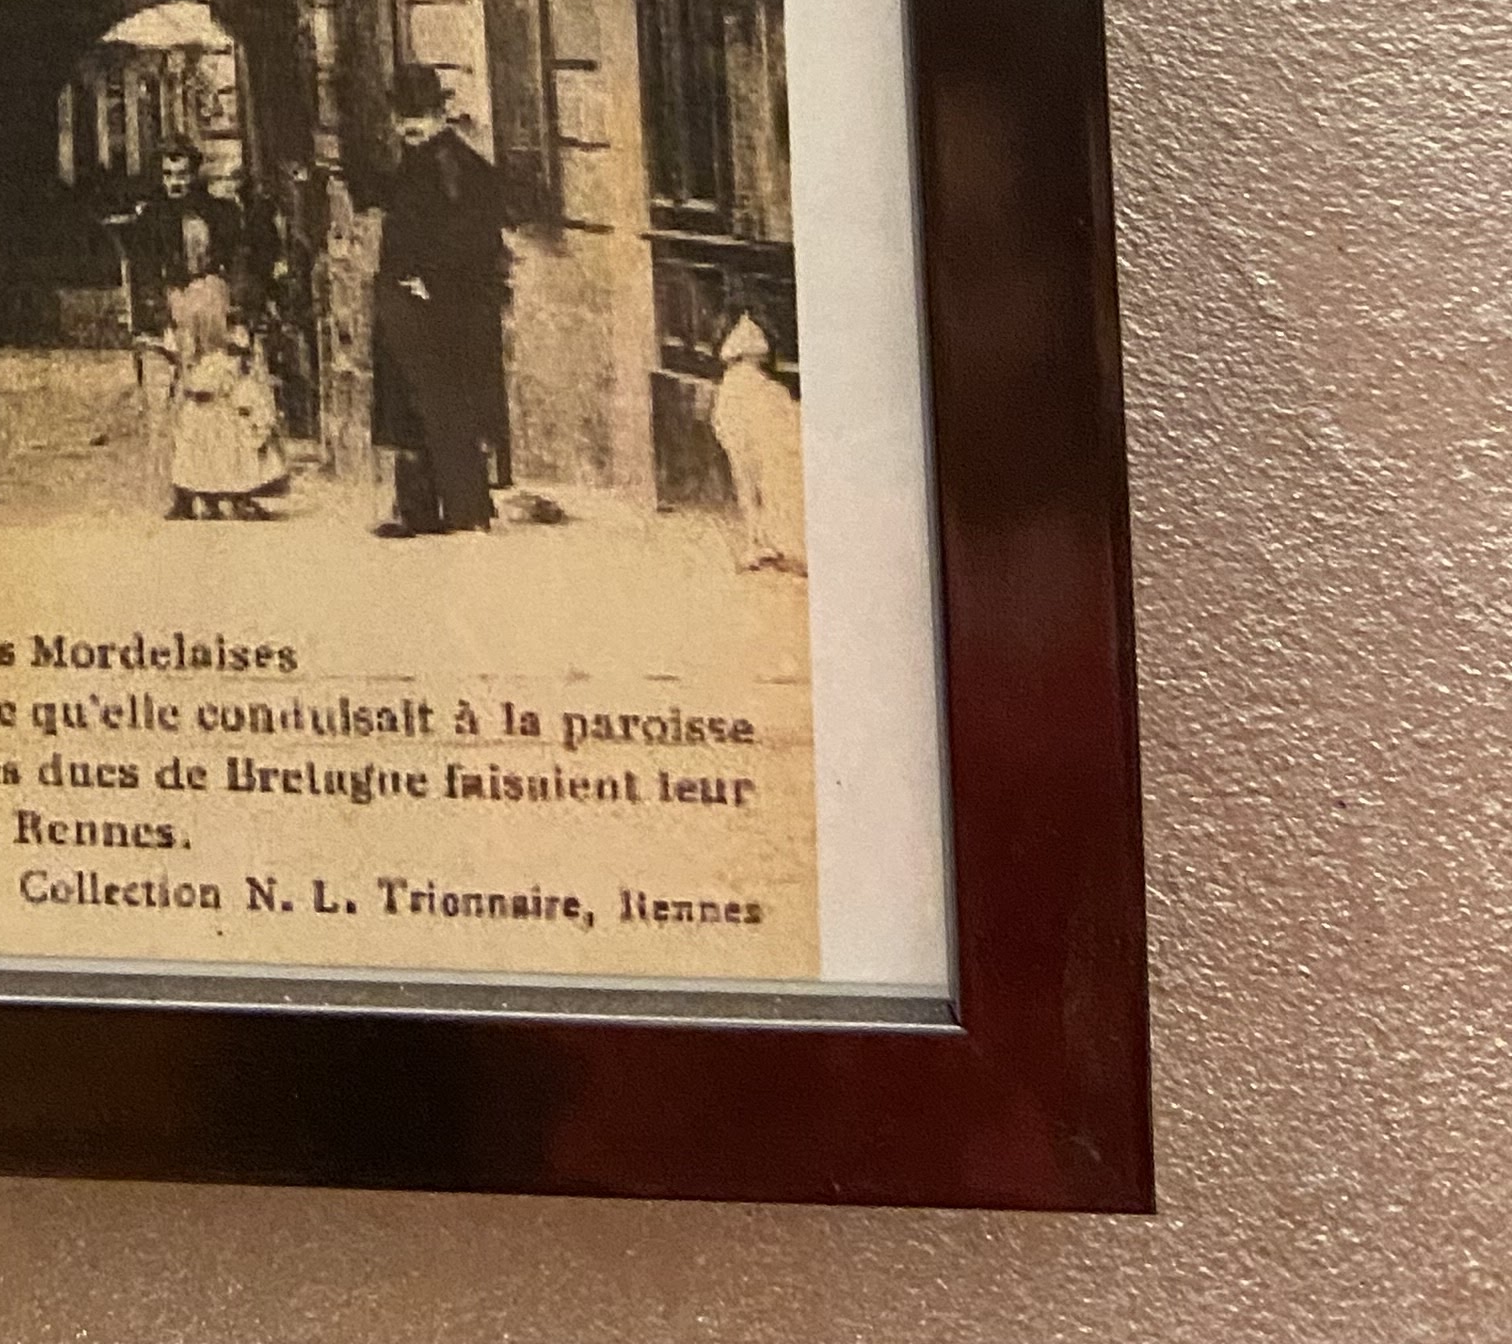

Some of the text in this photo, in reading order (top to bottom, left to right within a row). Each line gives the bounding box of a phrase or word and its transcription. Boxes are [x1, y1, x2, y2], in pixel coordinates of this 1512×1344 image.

[30, 632, 298, 673] Mordelaises
[31, 692, 180, 735] qu'elle
[197, 697, 434, 737] conduisait
[454, 699, 480, 736] à
[501, 700, 542, 738] la
[562, 706, 755, 751] paroisse
[37, 752, 139, 789] ducs
[154, 756, 207, 791] de
[227, 755, 428, 805] Bretagne
[443, 760, 641, 802] faisaient
[659, 769, 758, 808] leur
[13, 809, 192, 851] Rennes.
[19, 869, 765, 929] Collection N. L. Trionnaire, Rennes
